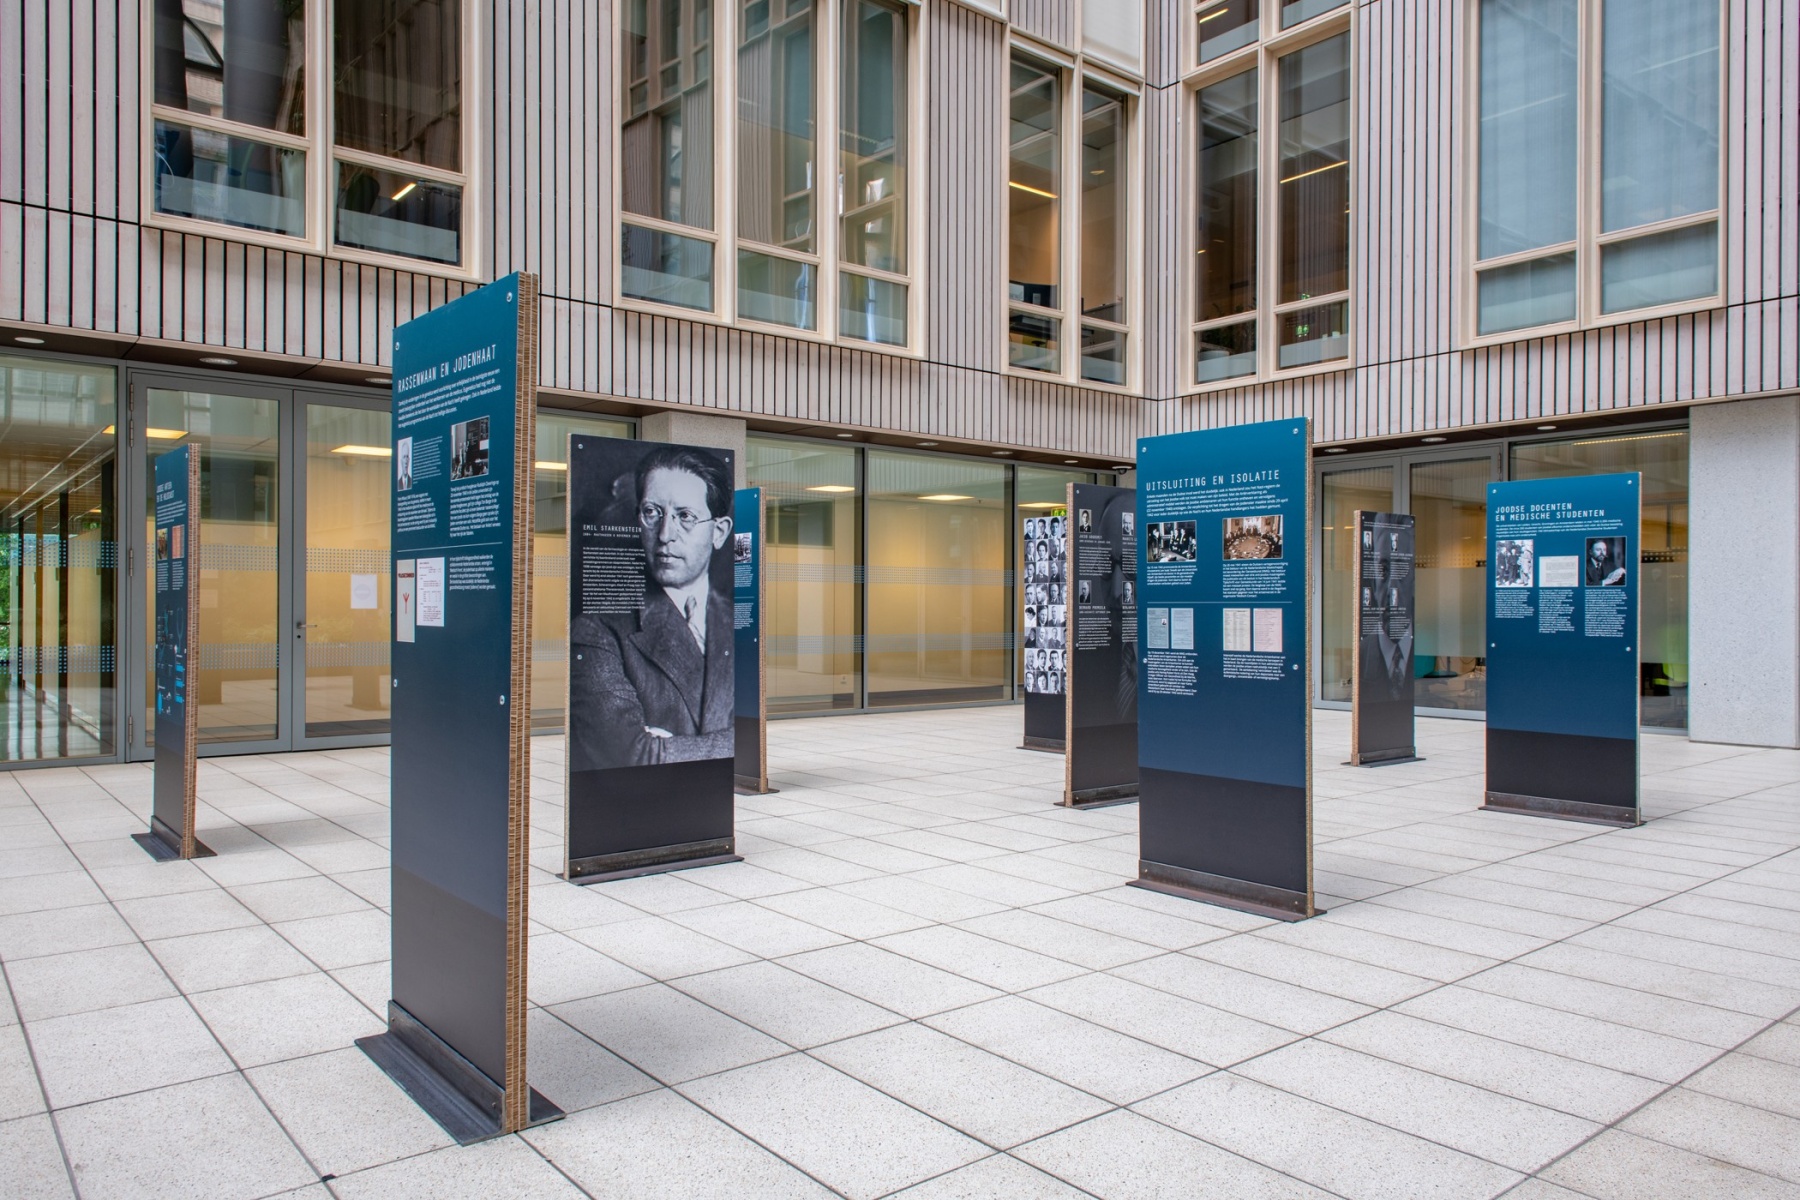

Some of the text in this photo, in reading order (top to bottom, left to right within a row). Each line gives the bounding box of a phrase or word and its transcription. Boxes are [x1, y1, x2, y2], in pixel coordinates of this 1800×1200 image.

[398, 368, 436, 393] RASSENWAAN
[440, 361, 449, 377] EN
[453, 344, 497, 373] JODENHAAT
[1146, 469, 1279, 491] UITSLUITING EN ISOLATIE
[1495, 503, 1572, 514] JOODSE DOCENTEN
[1495, 510, 1604, 522] EN MEDISCHE STUDENTEN
[601, 525, 642, 533] STARKENSTEIN
